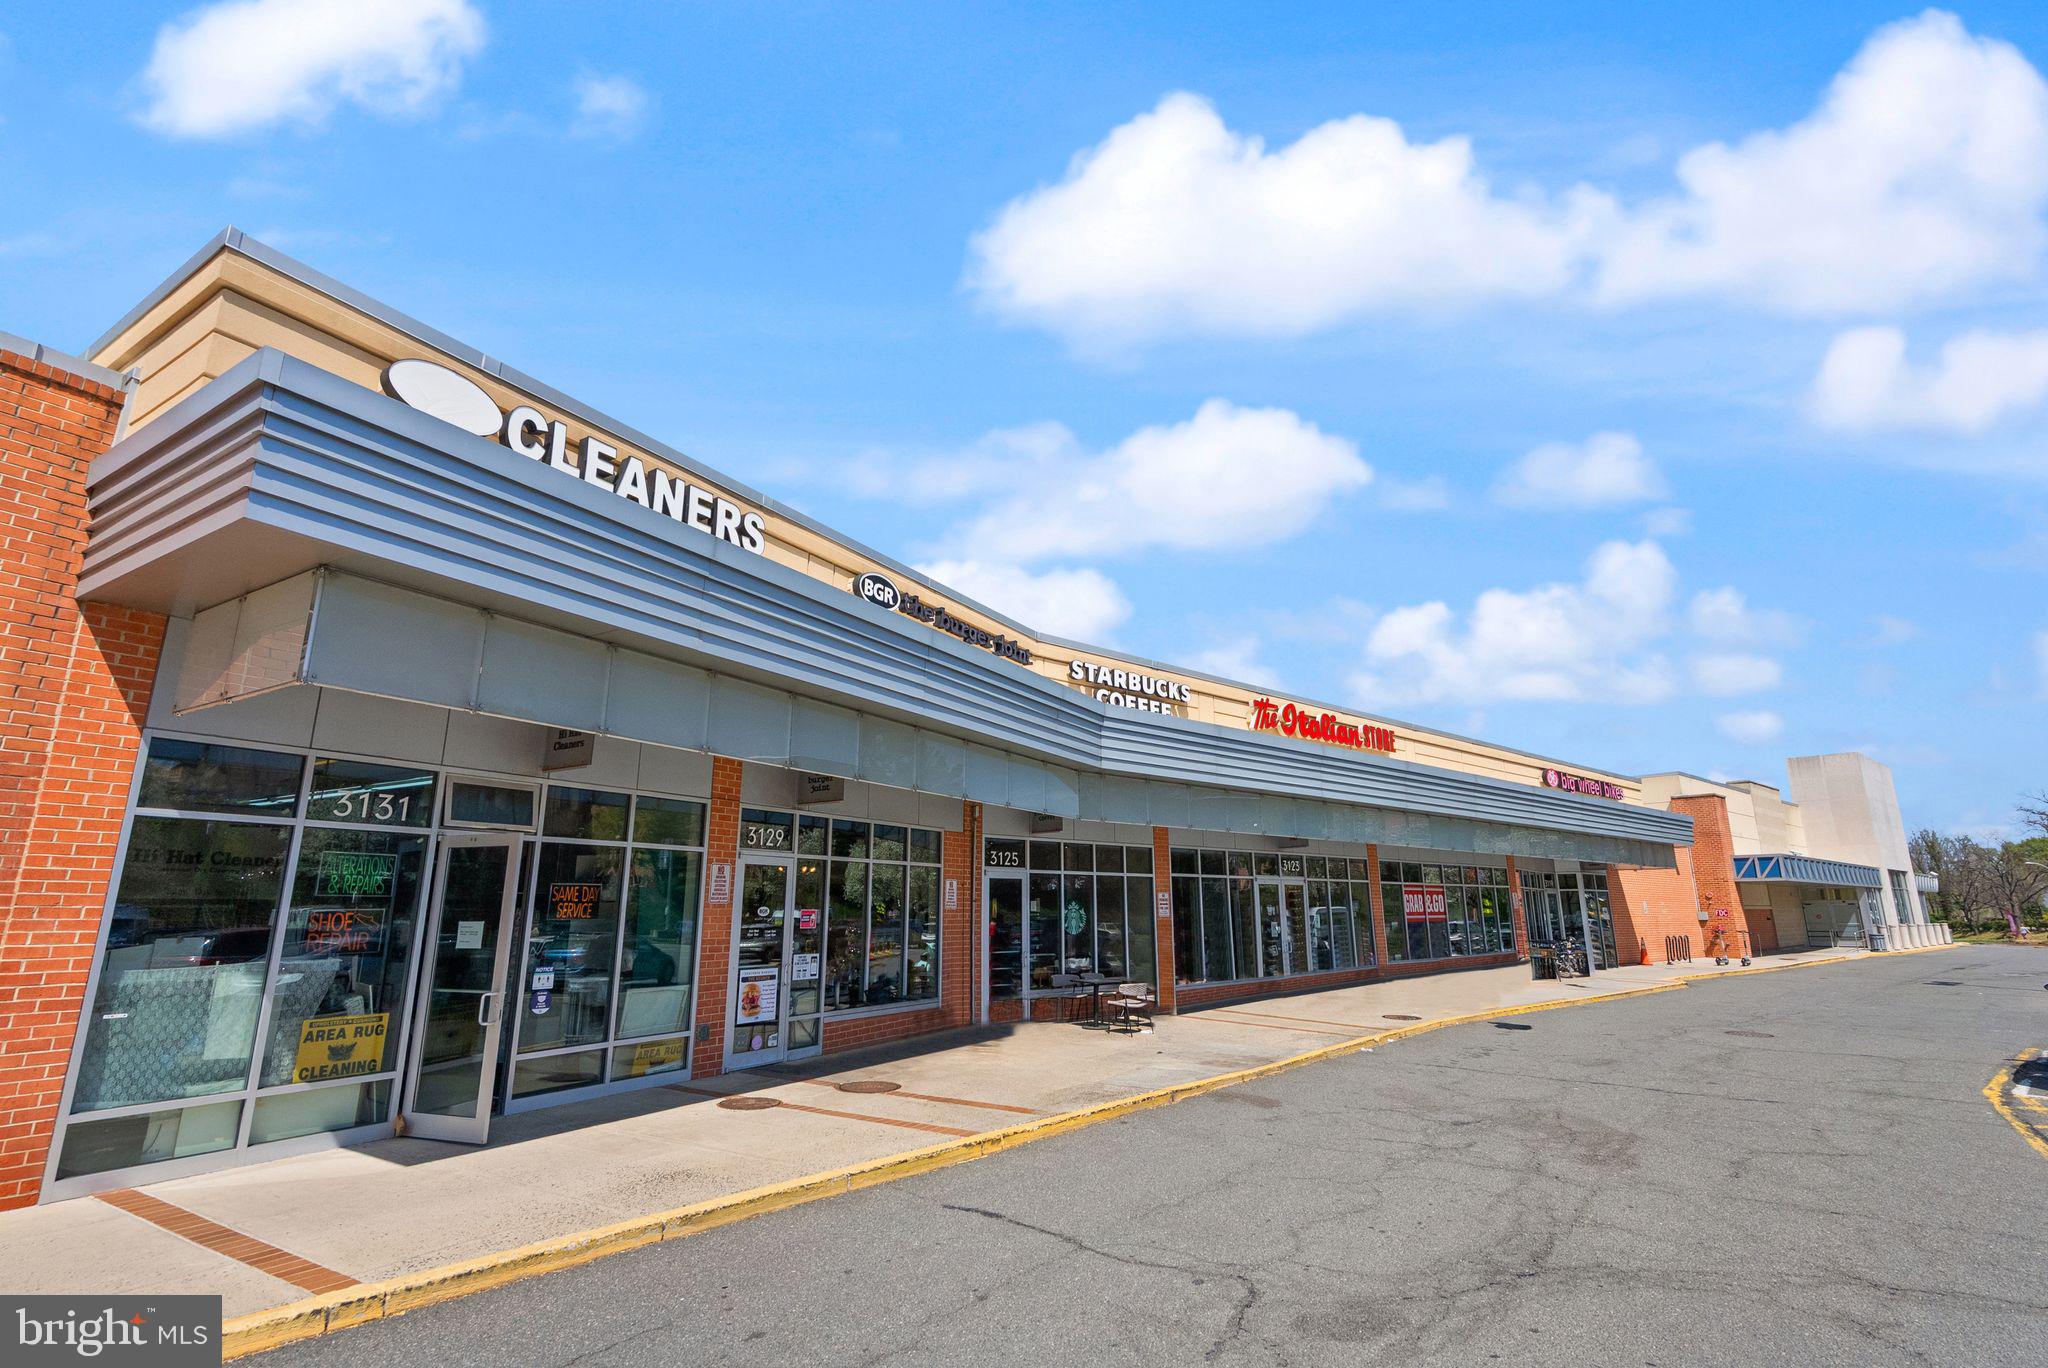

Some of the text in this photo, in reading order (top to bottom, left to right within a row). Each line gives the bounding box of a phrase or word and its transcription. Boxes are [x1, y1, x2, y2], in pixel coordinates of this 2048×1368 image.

[507, 405, 766, 556] CLEANERS
[864, 577, 896, 606] BGR
[899, 592, 936, 622] the
[934, 607, 994, 645] burger
[1070, 660, 1191, 702] STARBUCKS
[1096, 689, 1171, 715] COFFEE
[1253, 697, 1396, 752] The Italian STORE
[1560, 772, 1625, 800] big wheel bikes
[333, 791, 410, 822] 3131
[747, 826, 784, 847] 3129
[322, 854, 395, 876] ALTERATIONS
[990, 851, 1019, 866] 3125
[1282, 860, 1300, 871] 3123
[327, 873, 385, 894] & REPAIRS
[552, 886, 600, 902] SAME DAY
[556, 902, 593, 919] SERVICE
[1404, 894, 1425, 912] GRAB
[1715, 909, 1728, 917] FDC
[308, 911, 354, 933] SHOE
[305, 931, 370, 951] REPAIR
[303, 1024, 385, 1043] AREA RUG
[298, 1058, 377, 1081] CLEANING
